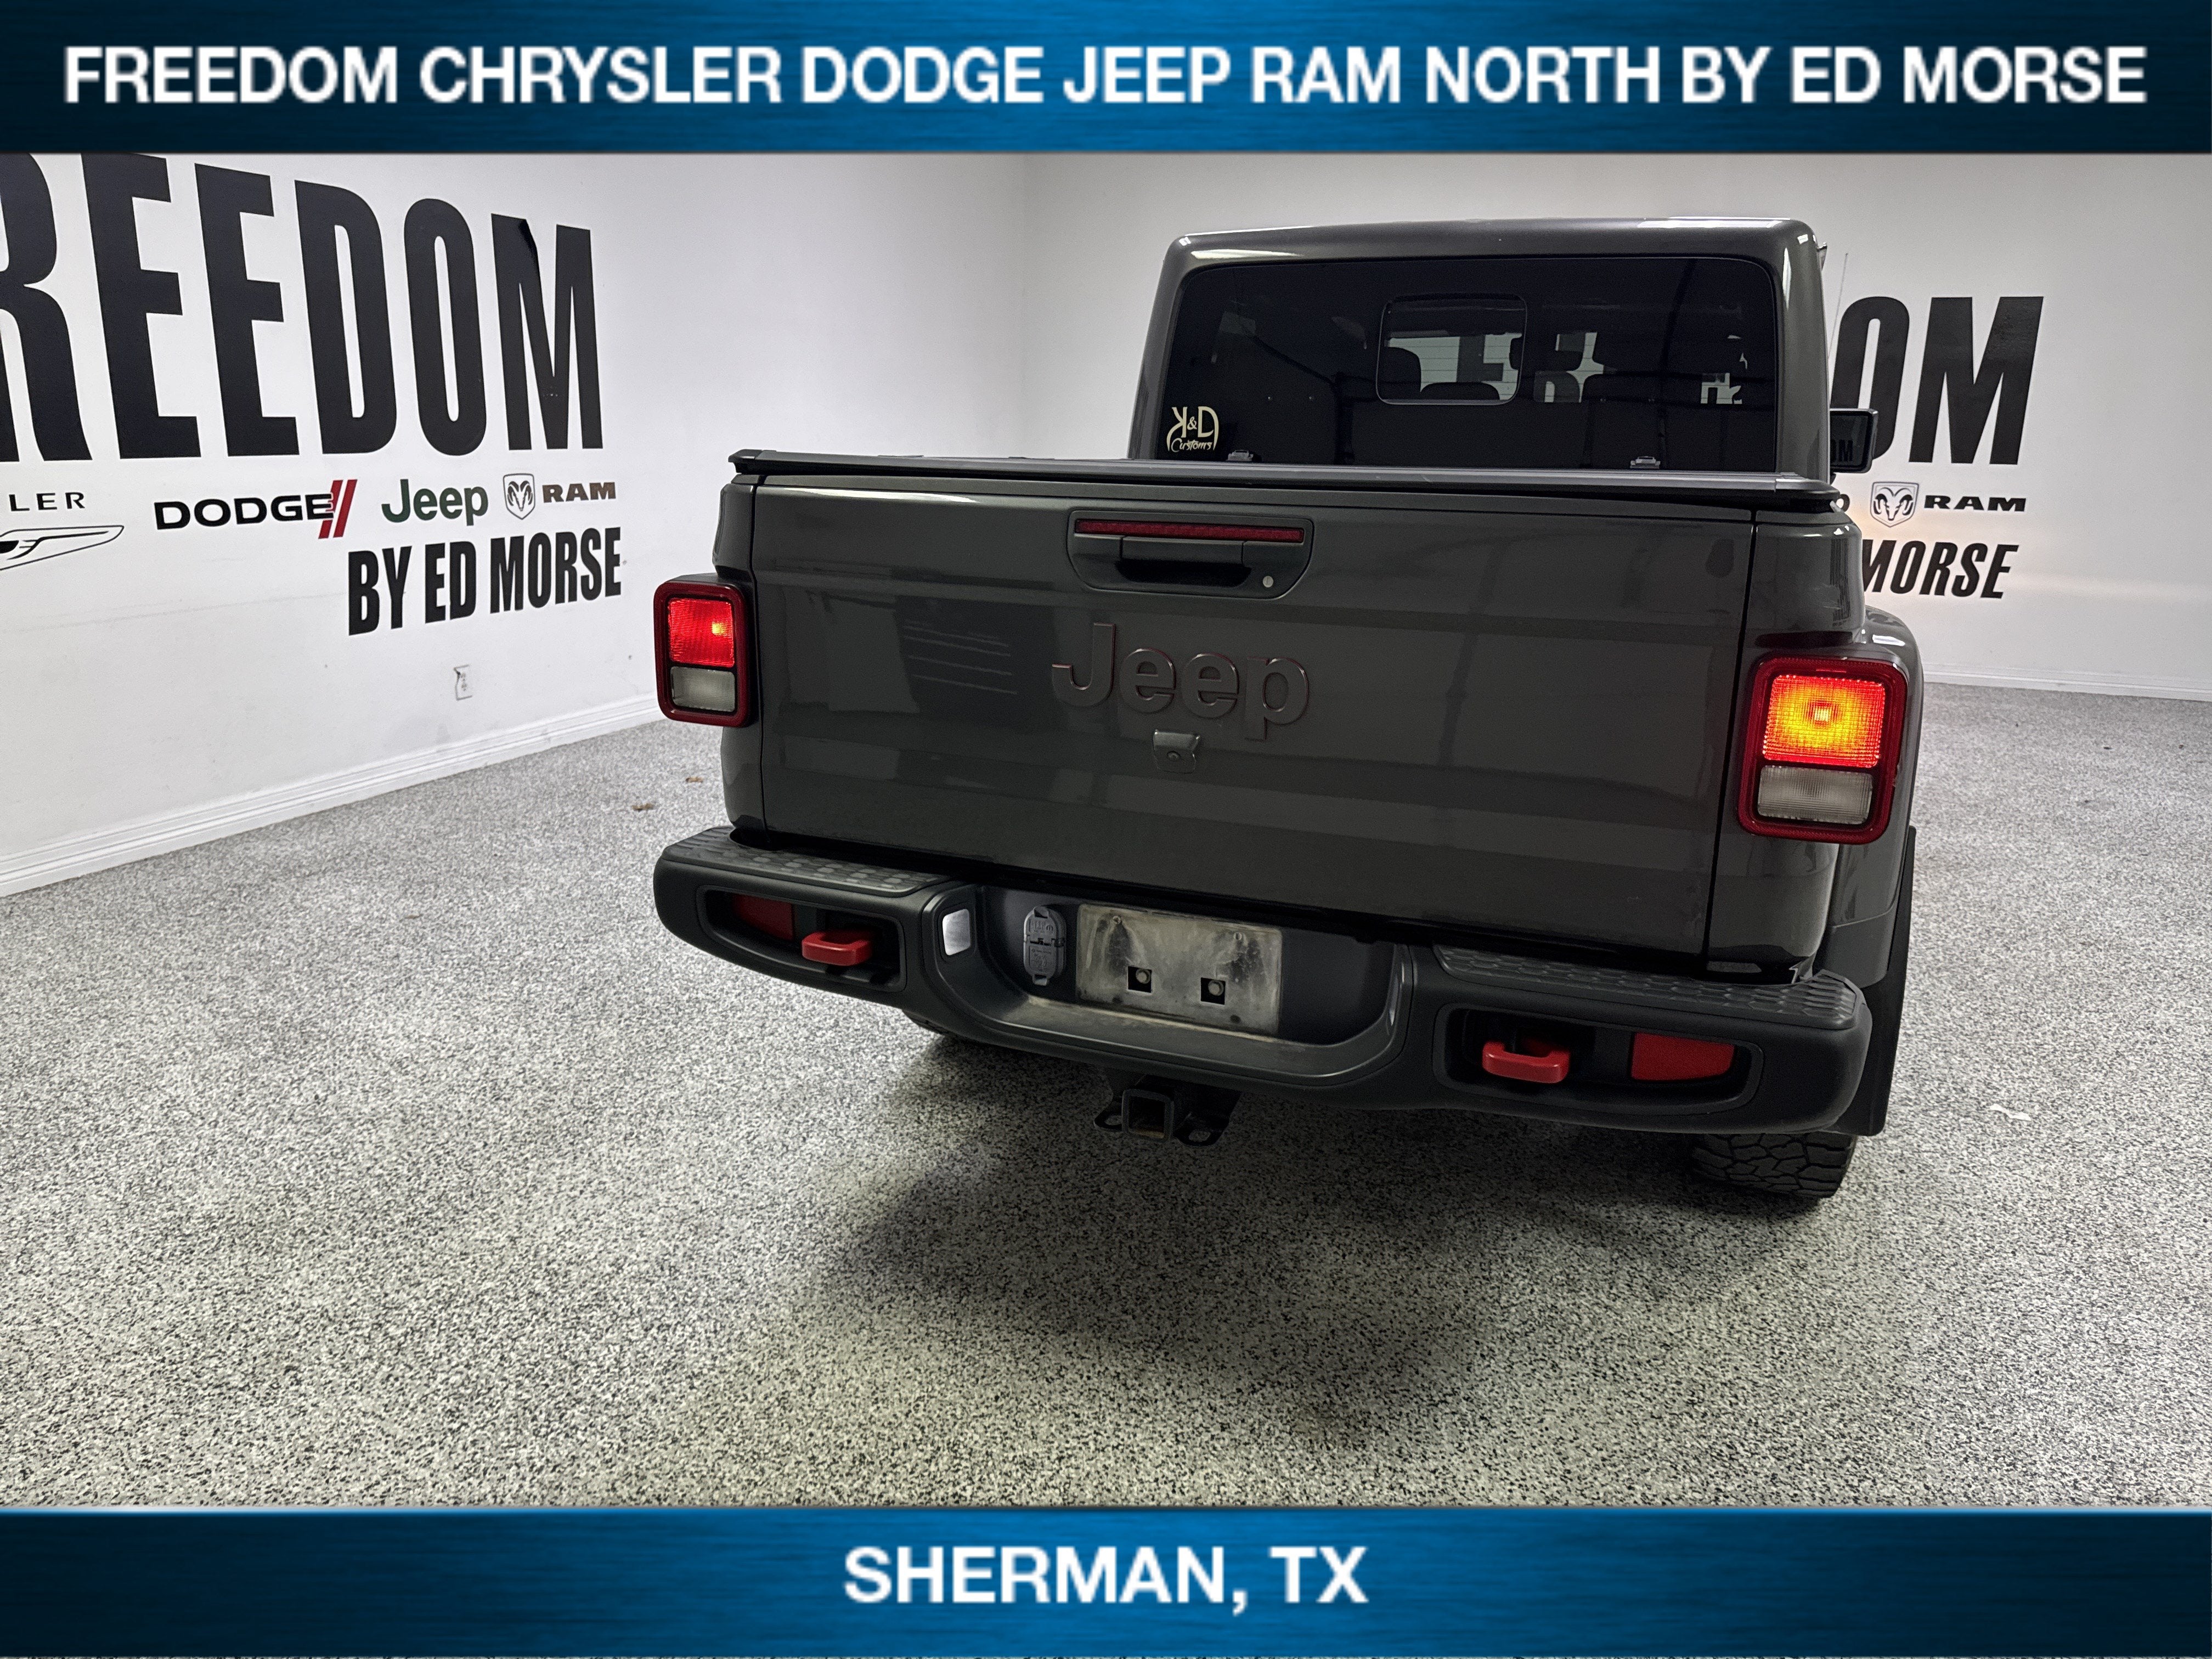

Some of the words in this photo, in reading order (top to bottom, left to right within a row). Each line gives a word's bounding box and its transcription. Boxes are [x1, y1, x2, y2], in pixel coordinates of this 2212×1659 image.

[1171, 437, 1213, 453] Customs
[154, 493, 334, 530] DODGE
[381, 478, 489, 526] Jeep
[542, 482, 616, 503] RAM
[1924, 495, 2027, 512] RAM
[348, 545, 412, 636] BY
[425, 541, 477, 624] ED
[490, 527, 622, 614] MORSE
[1862, 539, 2019, 599] MORSE
[1051, 622, 1310, 742] Jeep
